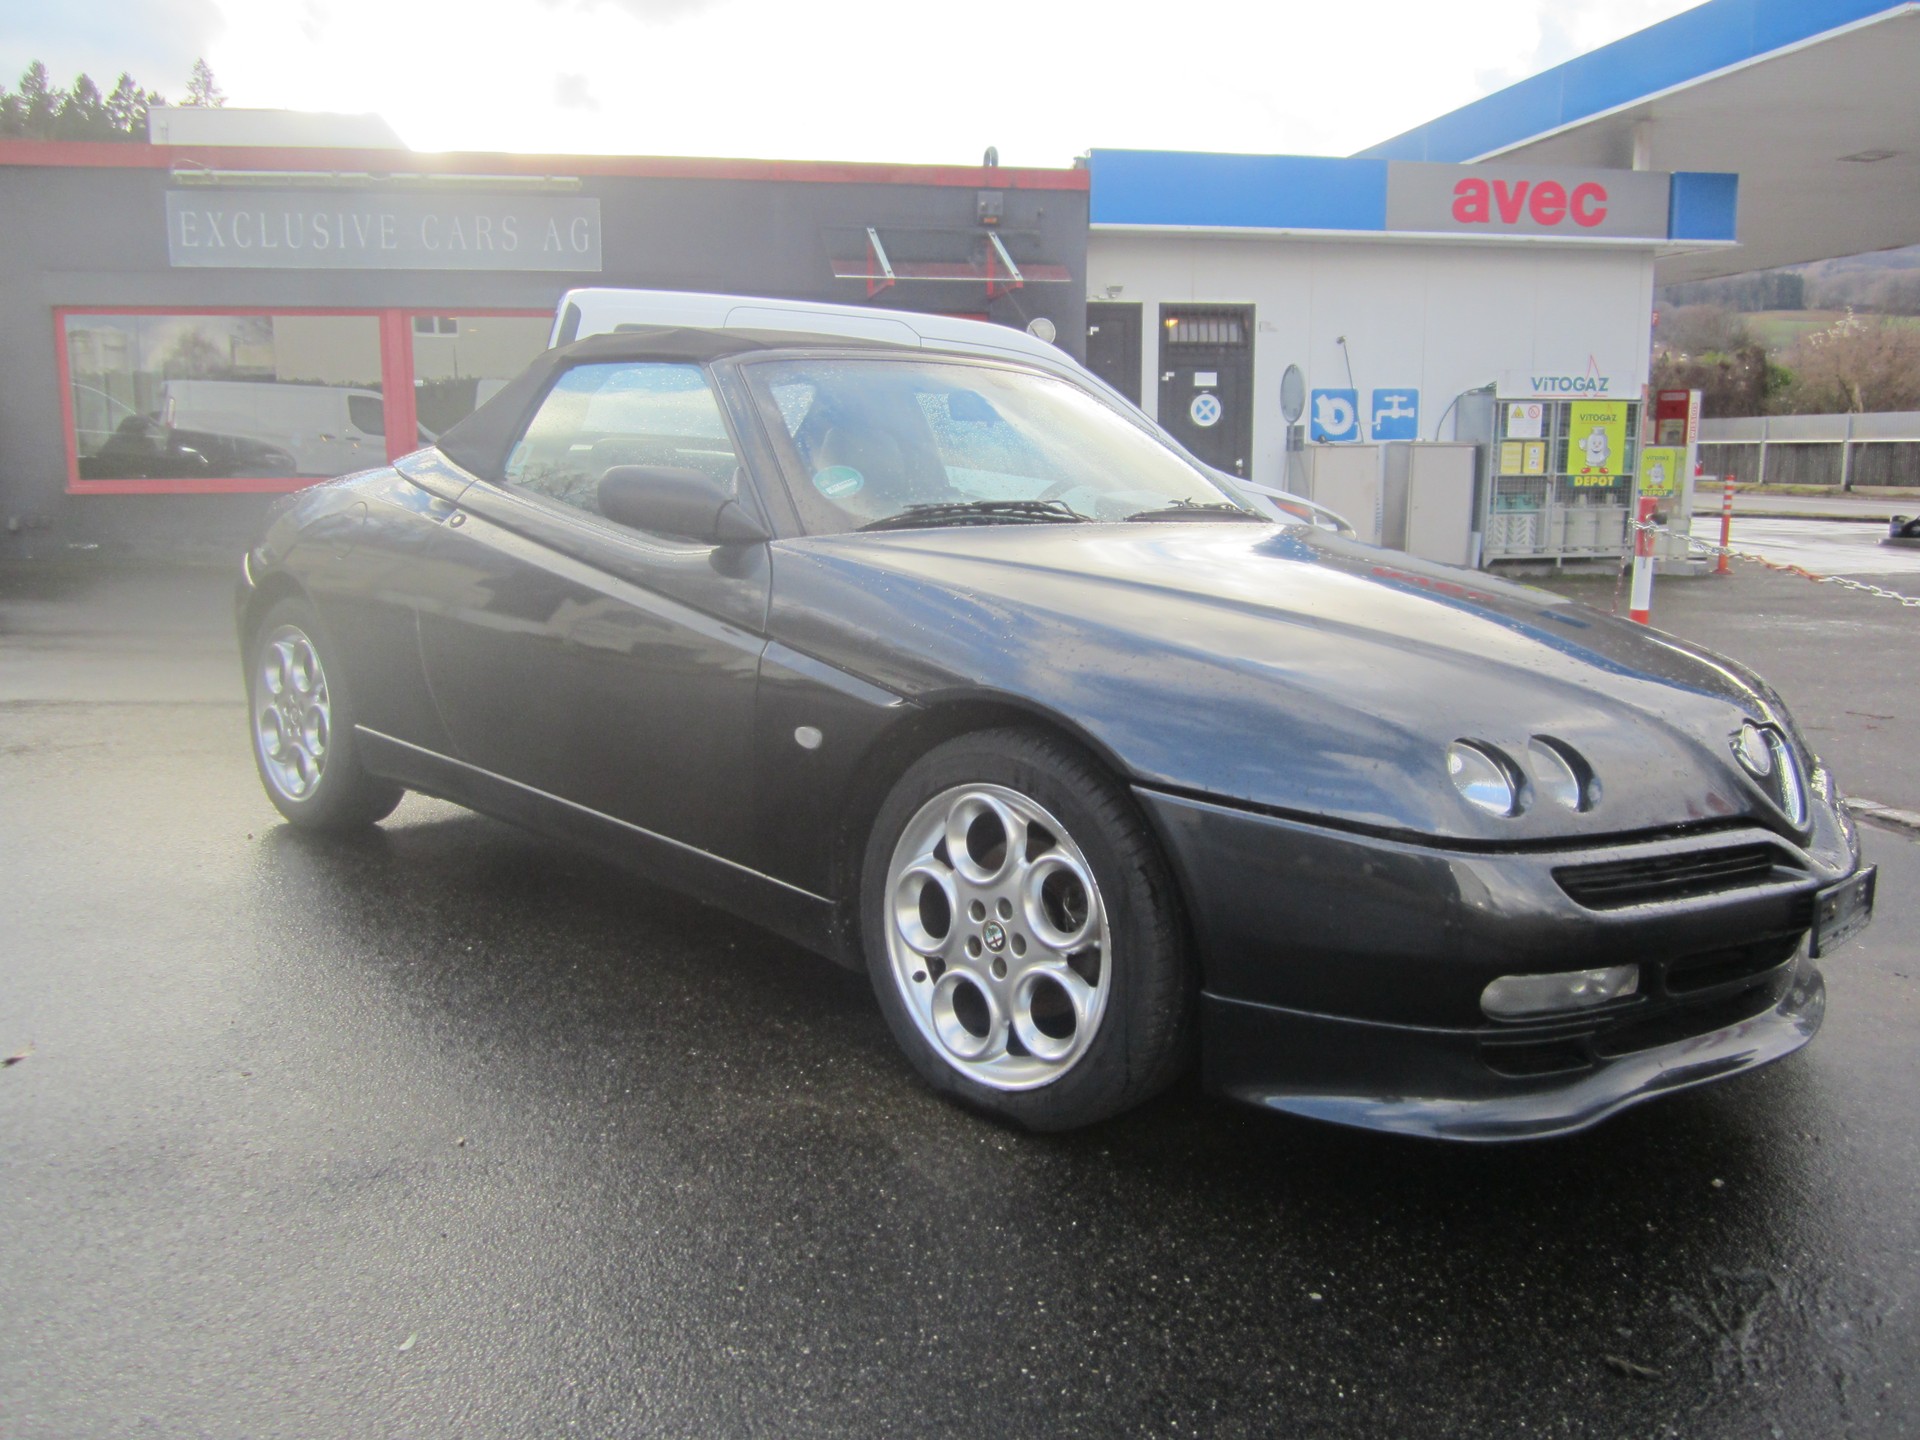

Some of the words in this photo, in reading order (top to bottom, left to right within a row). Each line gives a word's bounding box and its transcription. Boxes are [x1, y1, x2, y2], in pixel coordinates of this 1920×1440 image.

[1452, 177, 1608, 227] avec
[180, 211, 398, 250] EXCLUSIVE
[420, 214, 518, 252] CARS
[543, 216, 591, 253] AG
[1574, 475, 1615, 487] DEPOT
